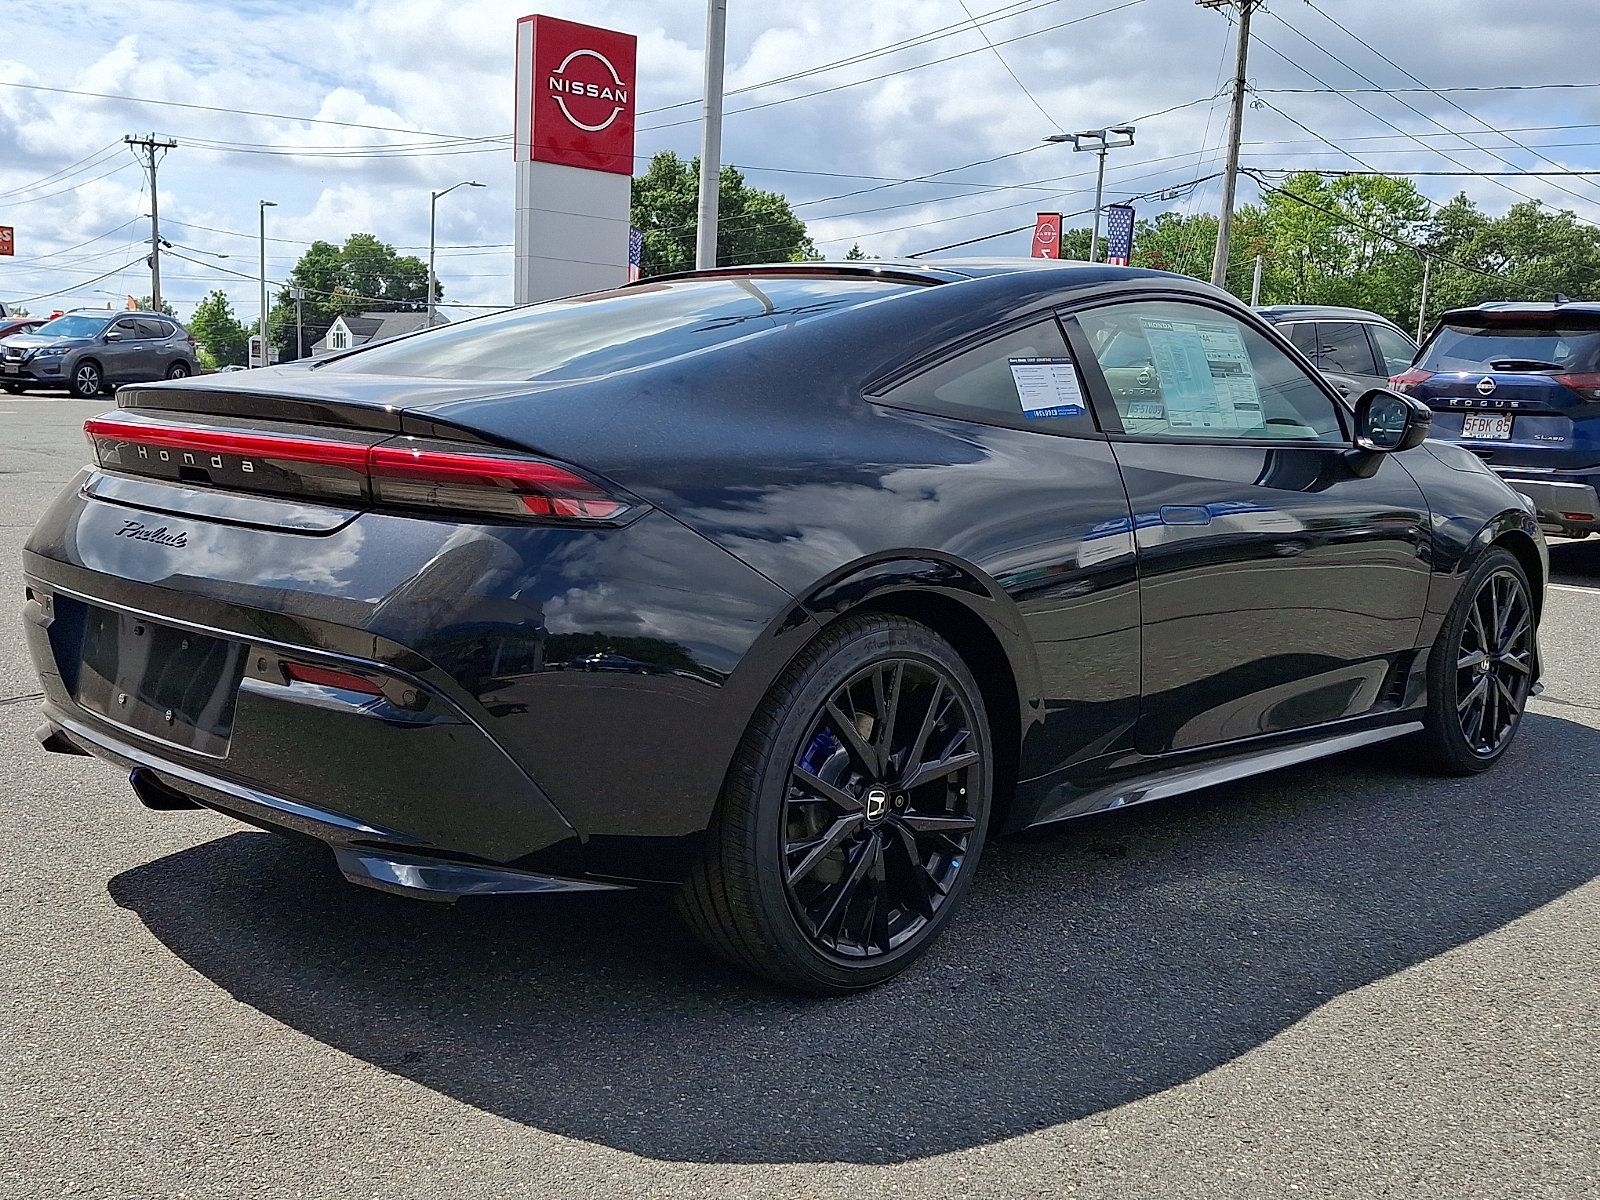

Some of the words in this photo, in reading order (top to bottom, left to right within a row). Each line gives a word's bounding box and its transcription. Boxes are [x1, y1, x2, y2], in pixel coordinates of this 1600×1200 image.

[549, 76, 628, 104] NISSAN
[1464, 418, 1494, 432] 5FBK
[1495, 419, 1511, 433] 85
[137, 445, 255, 473] Honda
[114, 520, 188, 548] Prelude
